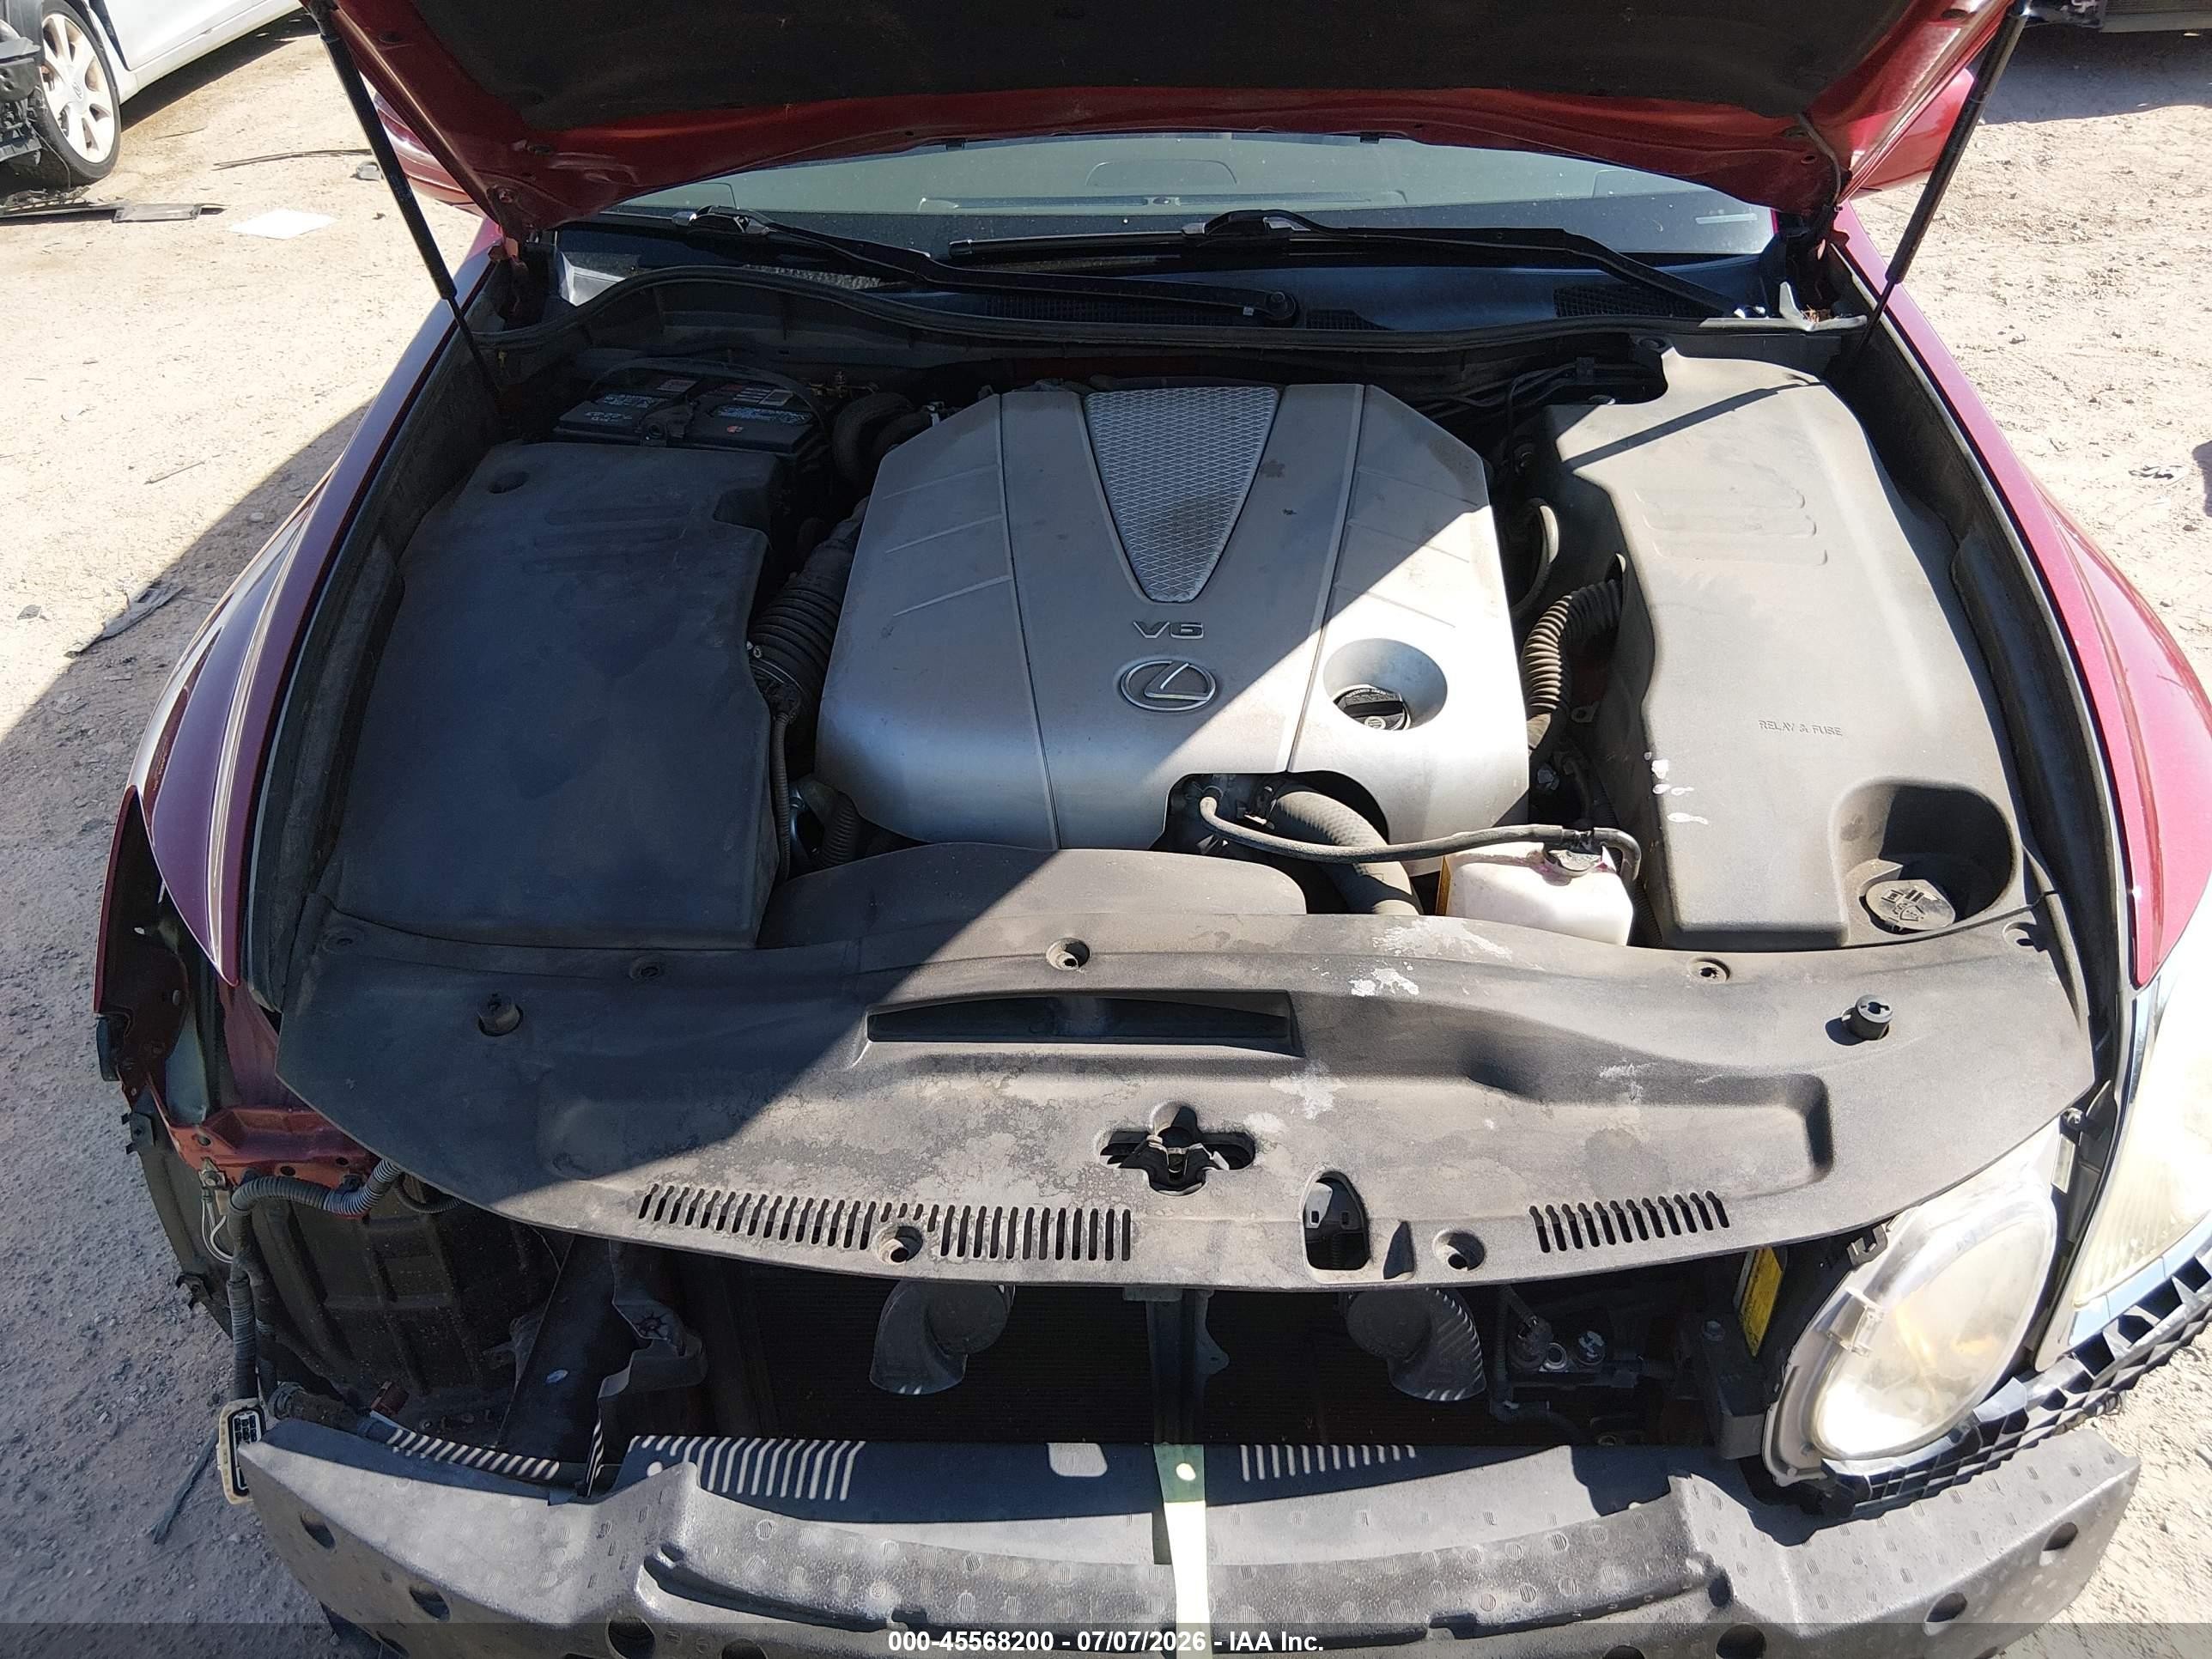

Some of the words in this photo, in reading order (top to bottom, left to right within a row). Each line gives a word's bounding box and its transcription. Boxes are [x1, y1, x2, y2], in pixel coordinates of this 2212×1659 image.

[1133, 621, 1204, 640] V6
[1758, 720, 1795, 732] RELAY
[1799, 723, 1809, 734] &
[1811, 724, 1843, 737] FUSE
